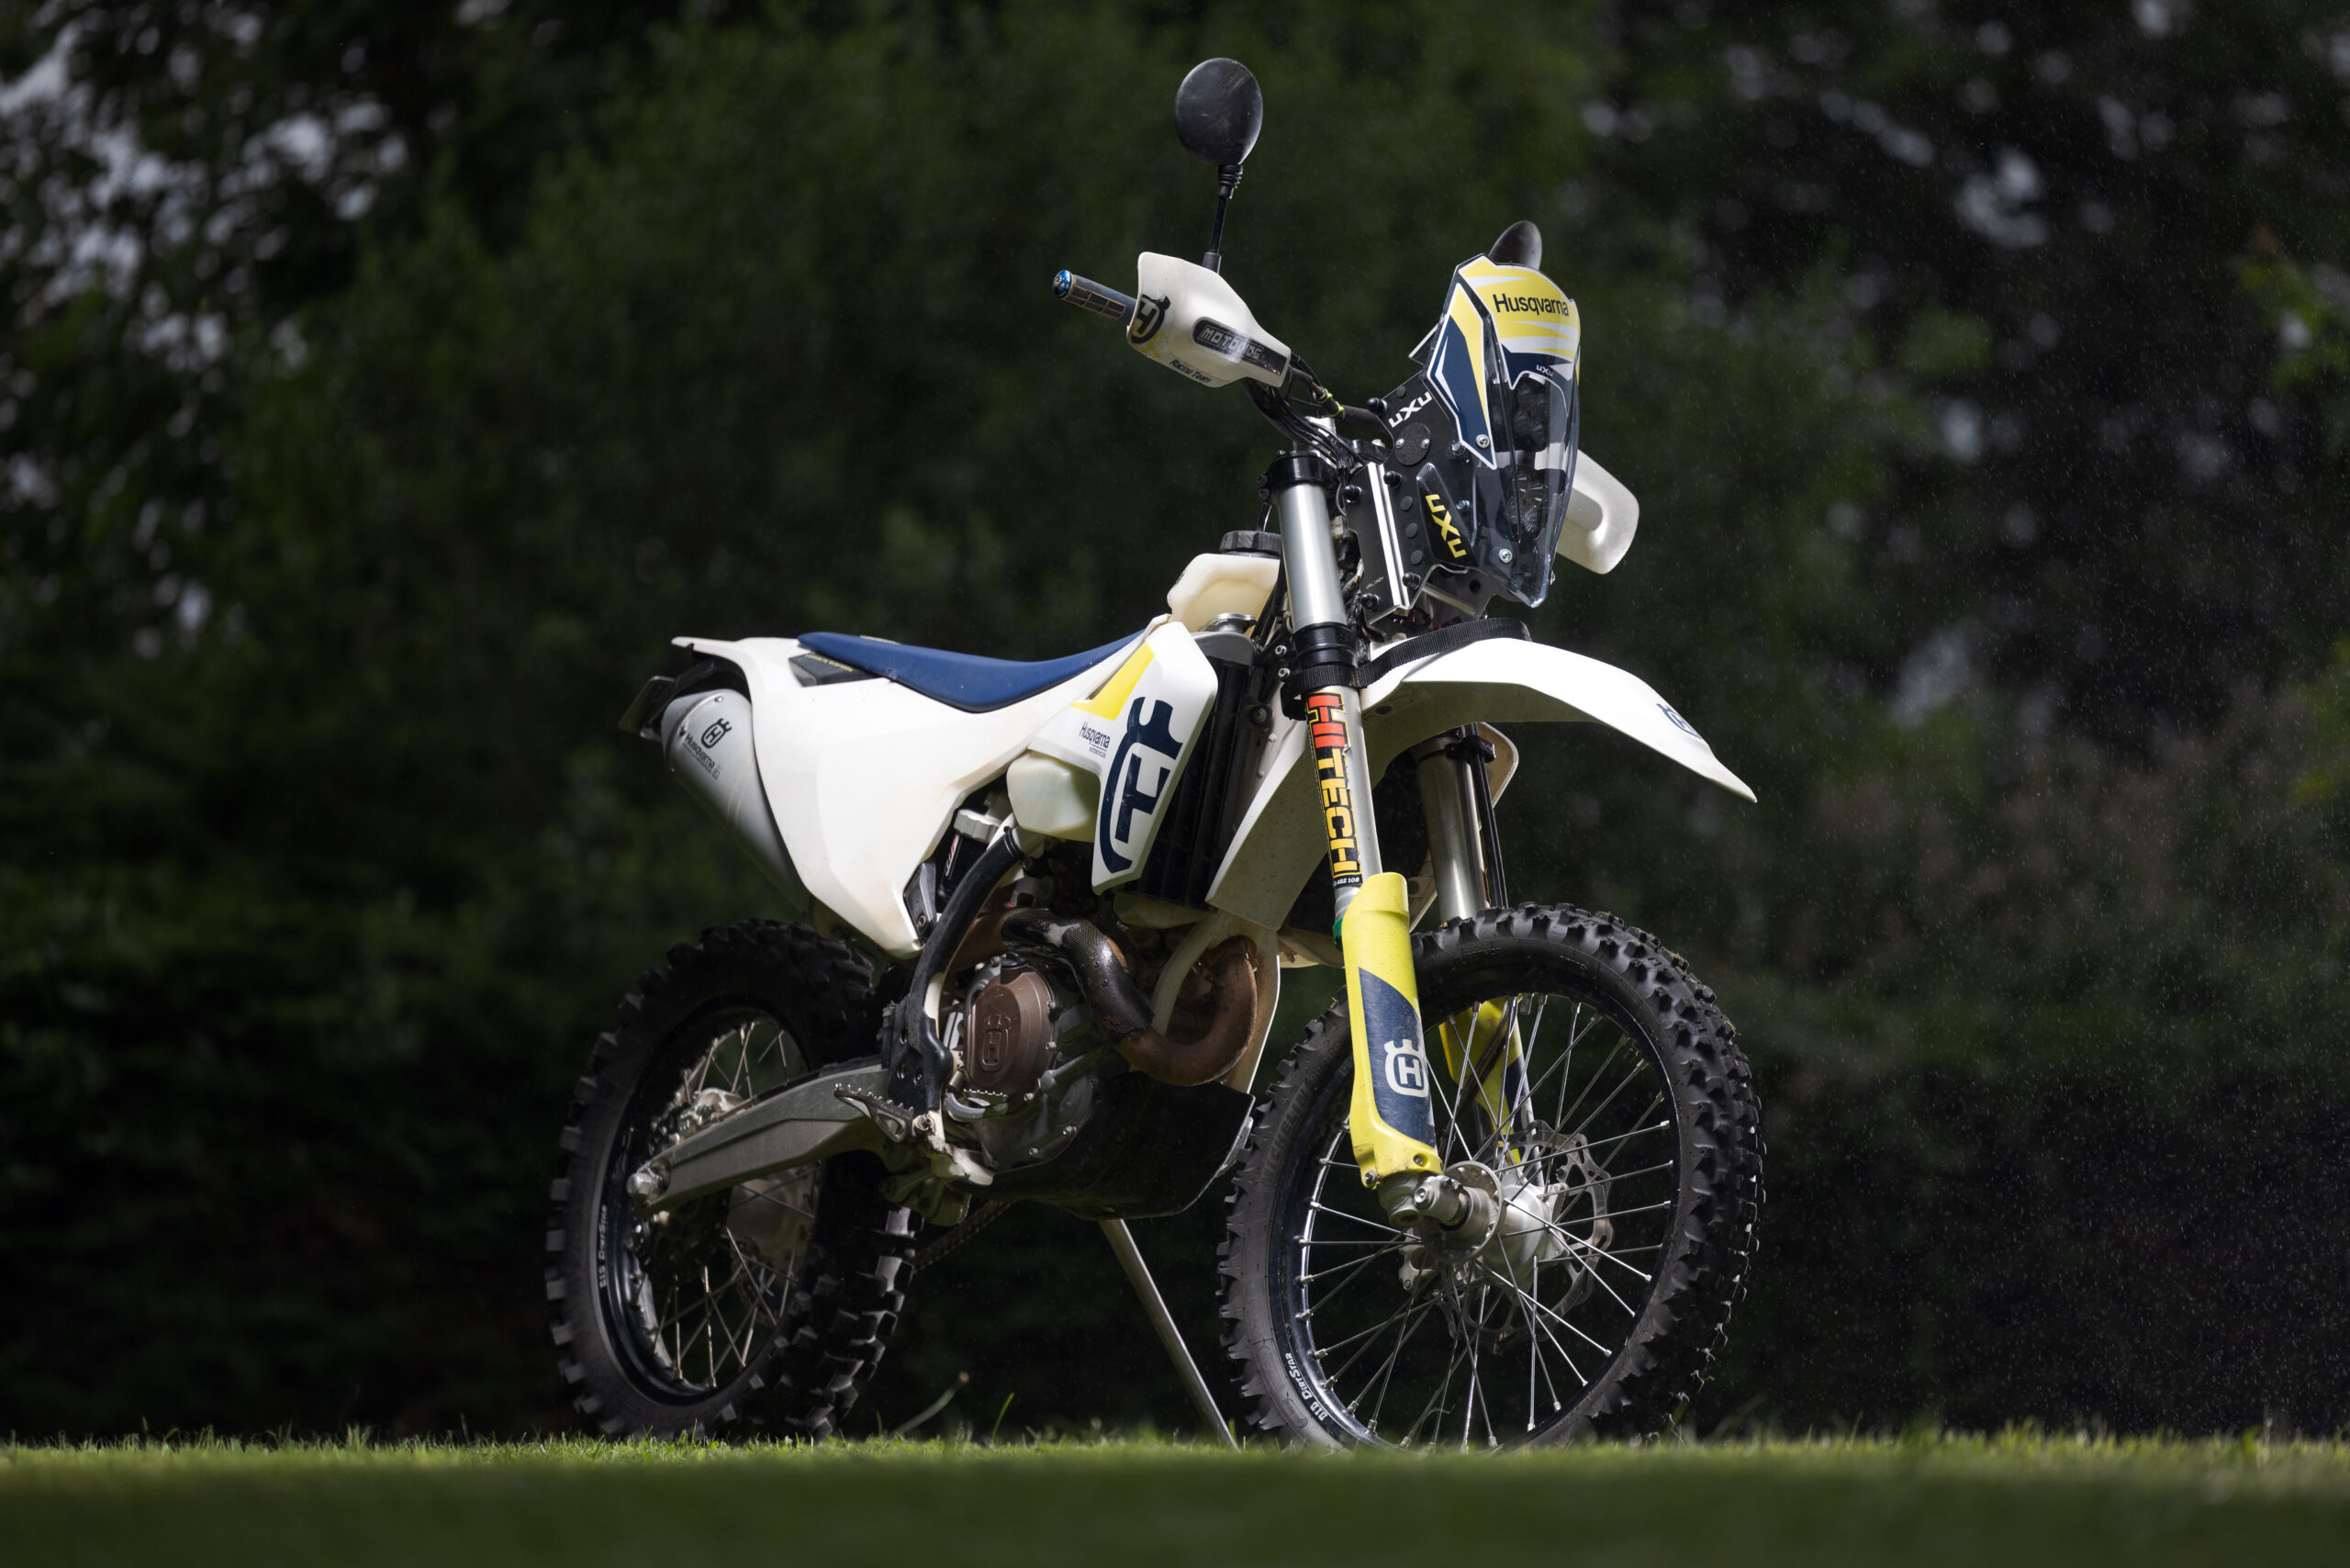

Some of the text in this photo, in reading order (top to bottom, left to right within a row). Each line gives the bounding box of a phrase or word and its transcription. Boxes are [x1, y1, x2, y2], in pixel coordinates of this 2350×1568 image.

[1493, 293, 1570, 317] Husqvarna
[1080, 722, 1110, 748] Husqvarna
[684, 734, 716, 769] Husqvarna
